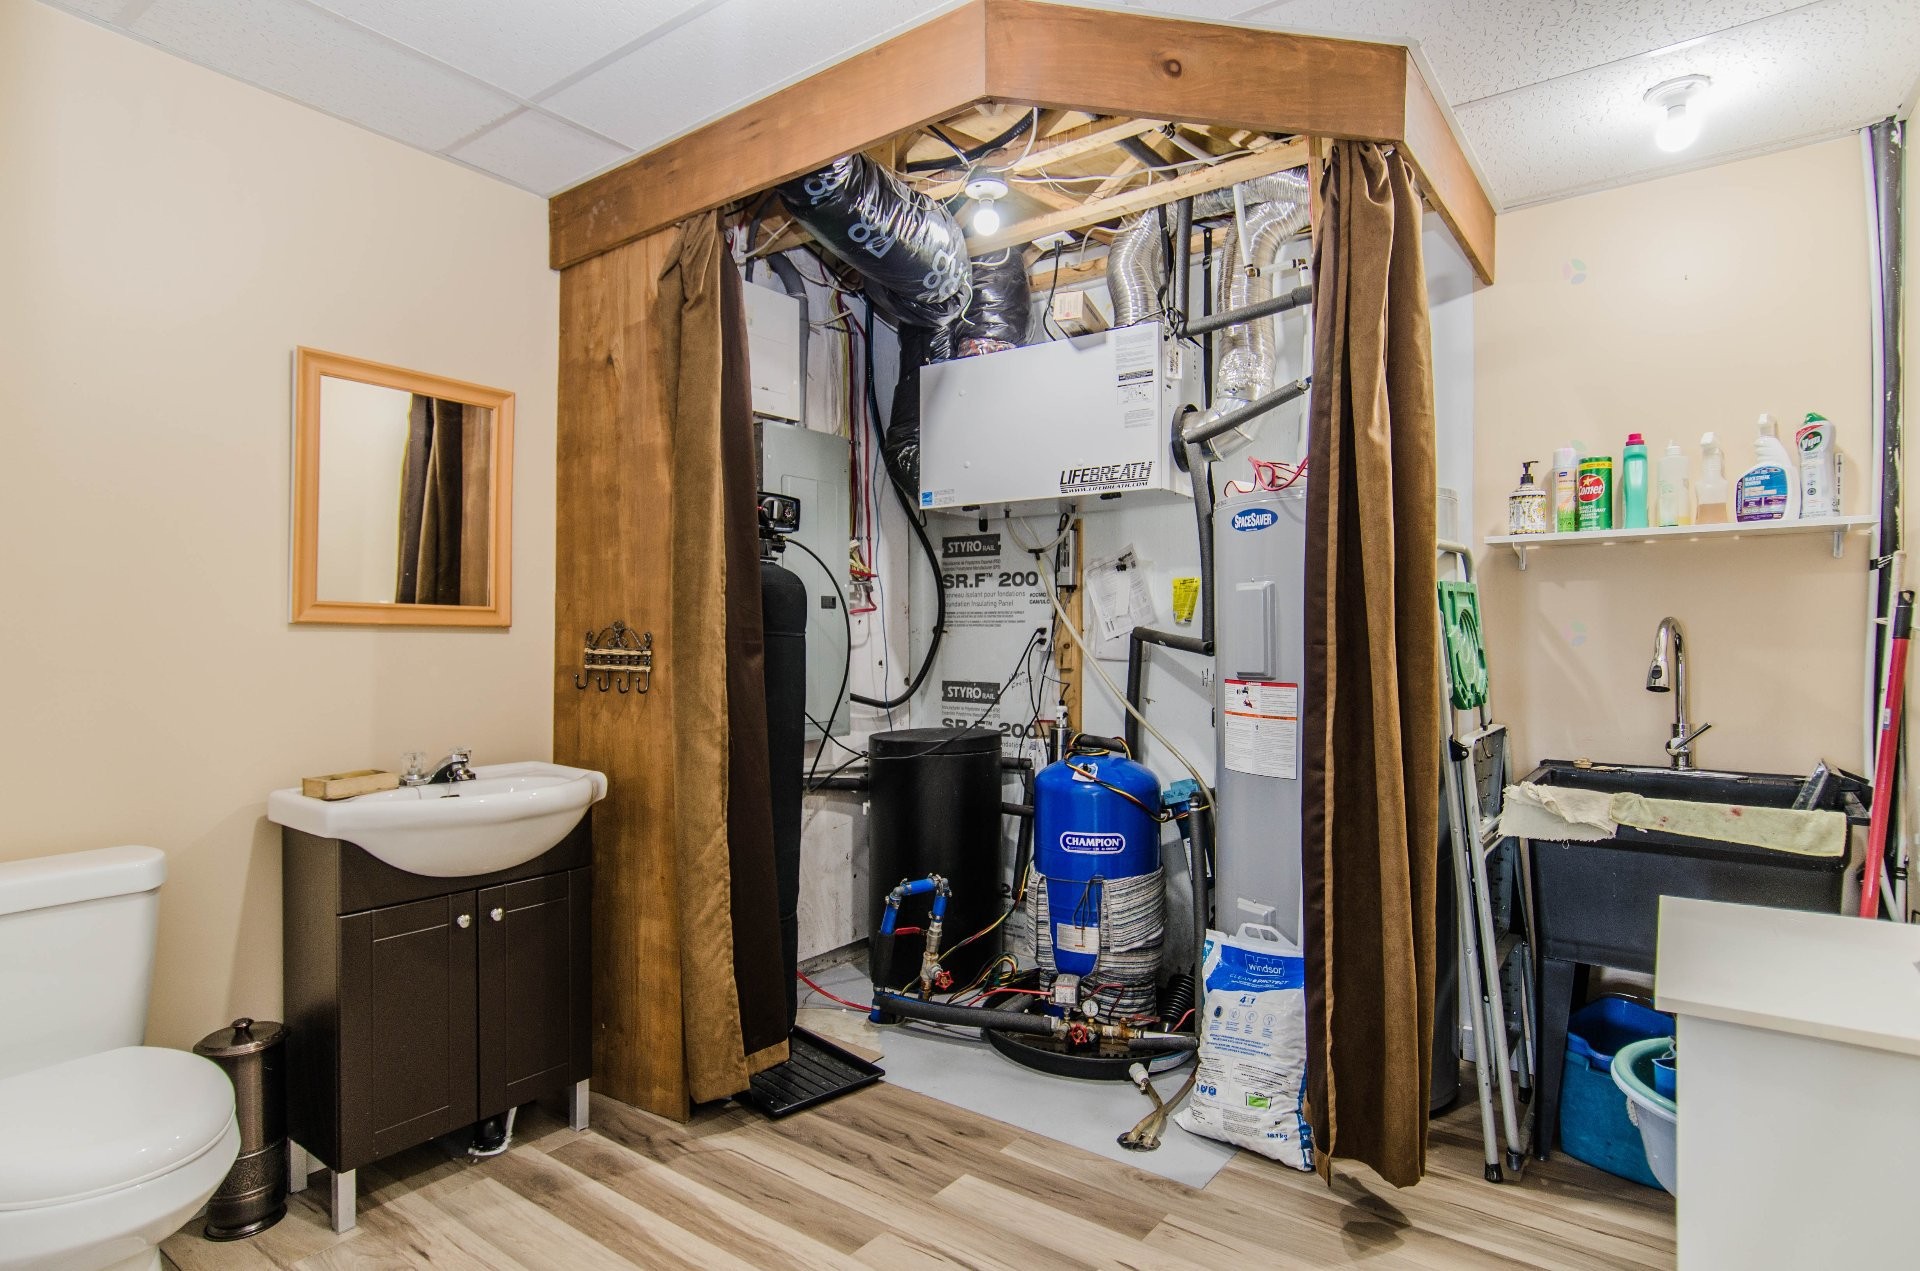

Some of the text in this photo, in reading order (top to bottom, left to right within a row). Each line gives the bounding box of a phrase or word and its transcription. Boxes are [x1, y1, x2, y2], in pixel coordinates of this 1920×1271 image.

[1060, 461, 1153, 484] LIFEBREATH
[1234, 512, 1272, 529] SPACESAVER
[947, 540, 982, 553] STYRO
[998, 571, 1039, 587] 200
[945, 591, 964, 599] anneau
[983, 591, 996, 599] pour
[947, 686, 996, 700] STYRO RAIL
[1065, 836, 1120, 847] CHAMPION
[1248, 962, 1283, 975] windsor
